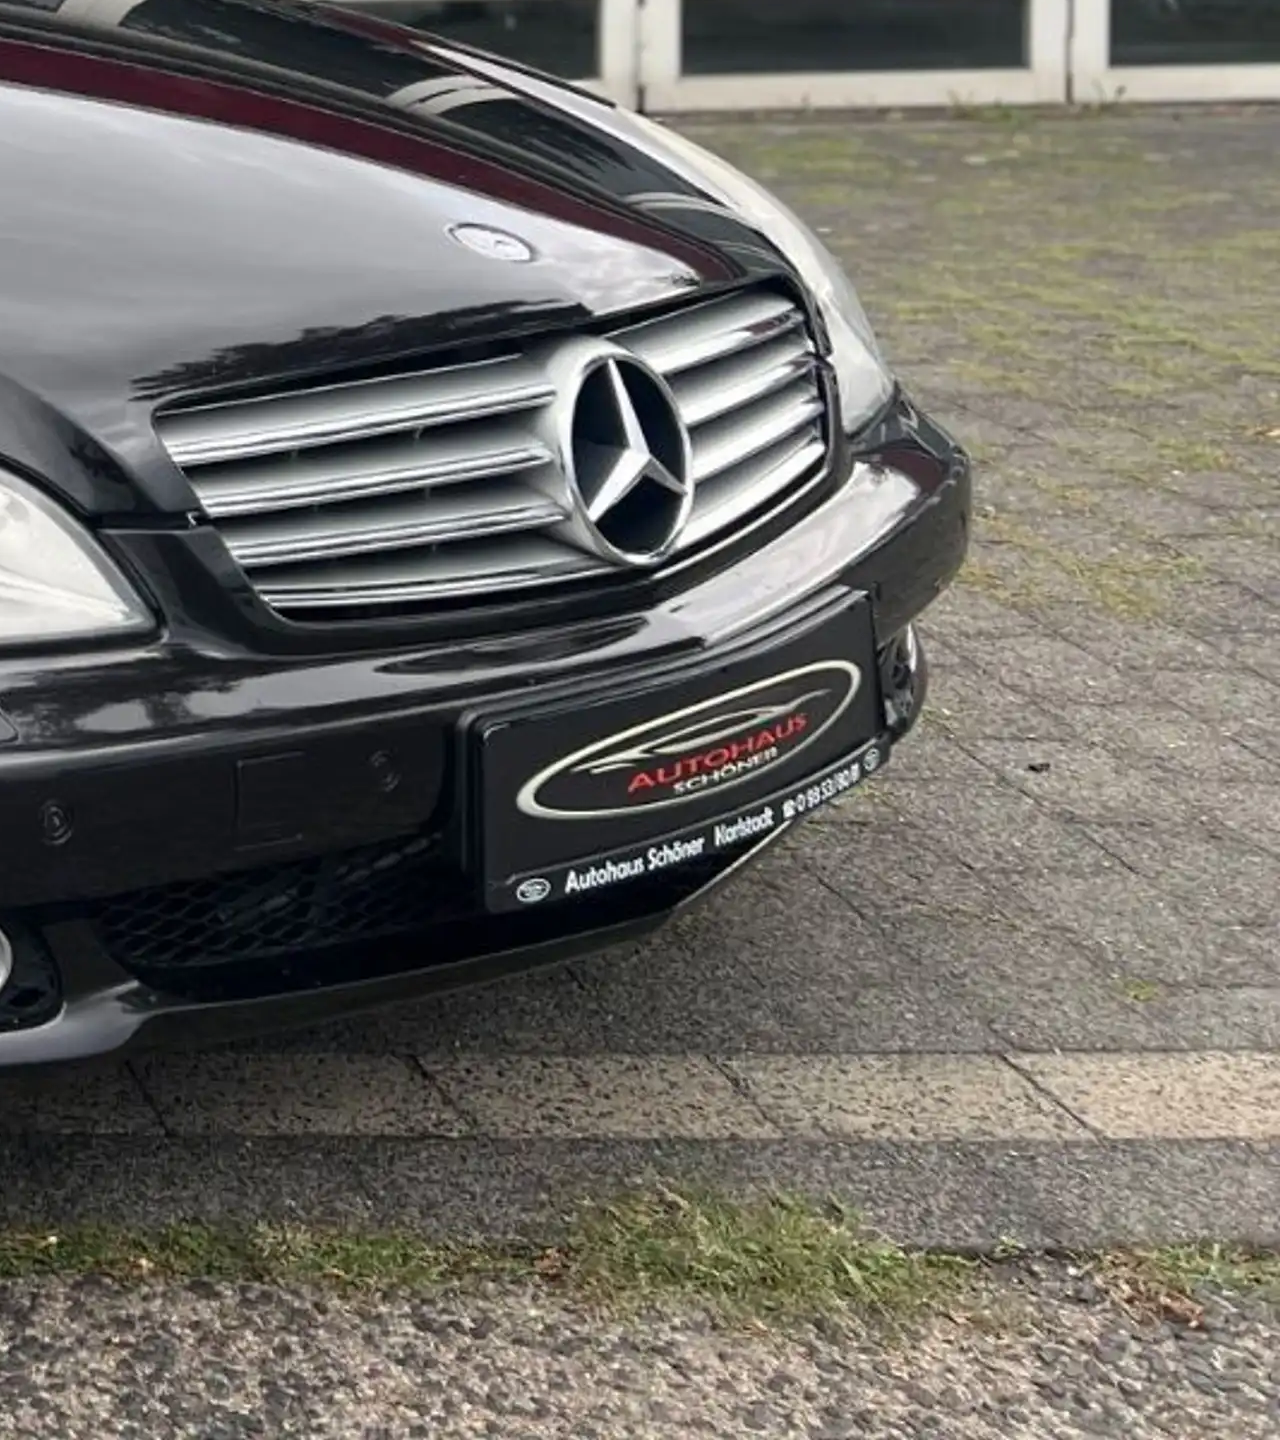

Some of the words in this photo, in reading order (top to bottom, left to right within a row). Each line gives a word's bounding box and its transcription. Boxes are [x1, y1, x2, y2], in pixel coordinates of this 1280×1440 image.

[627, 712, 808, 794] AUTOHAUS
[672, 746, 778, 795] SCHÖNER
[564, 856, 644, 894] Autohaus
[647, 836, 705, 871] Schöner
